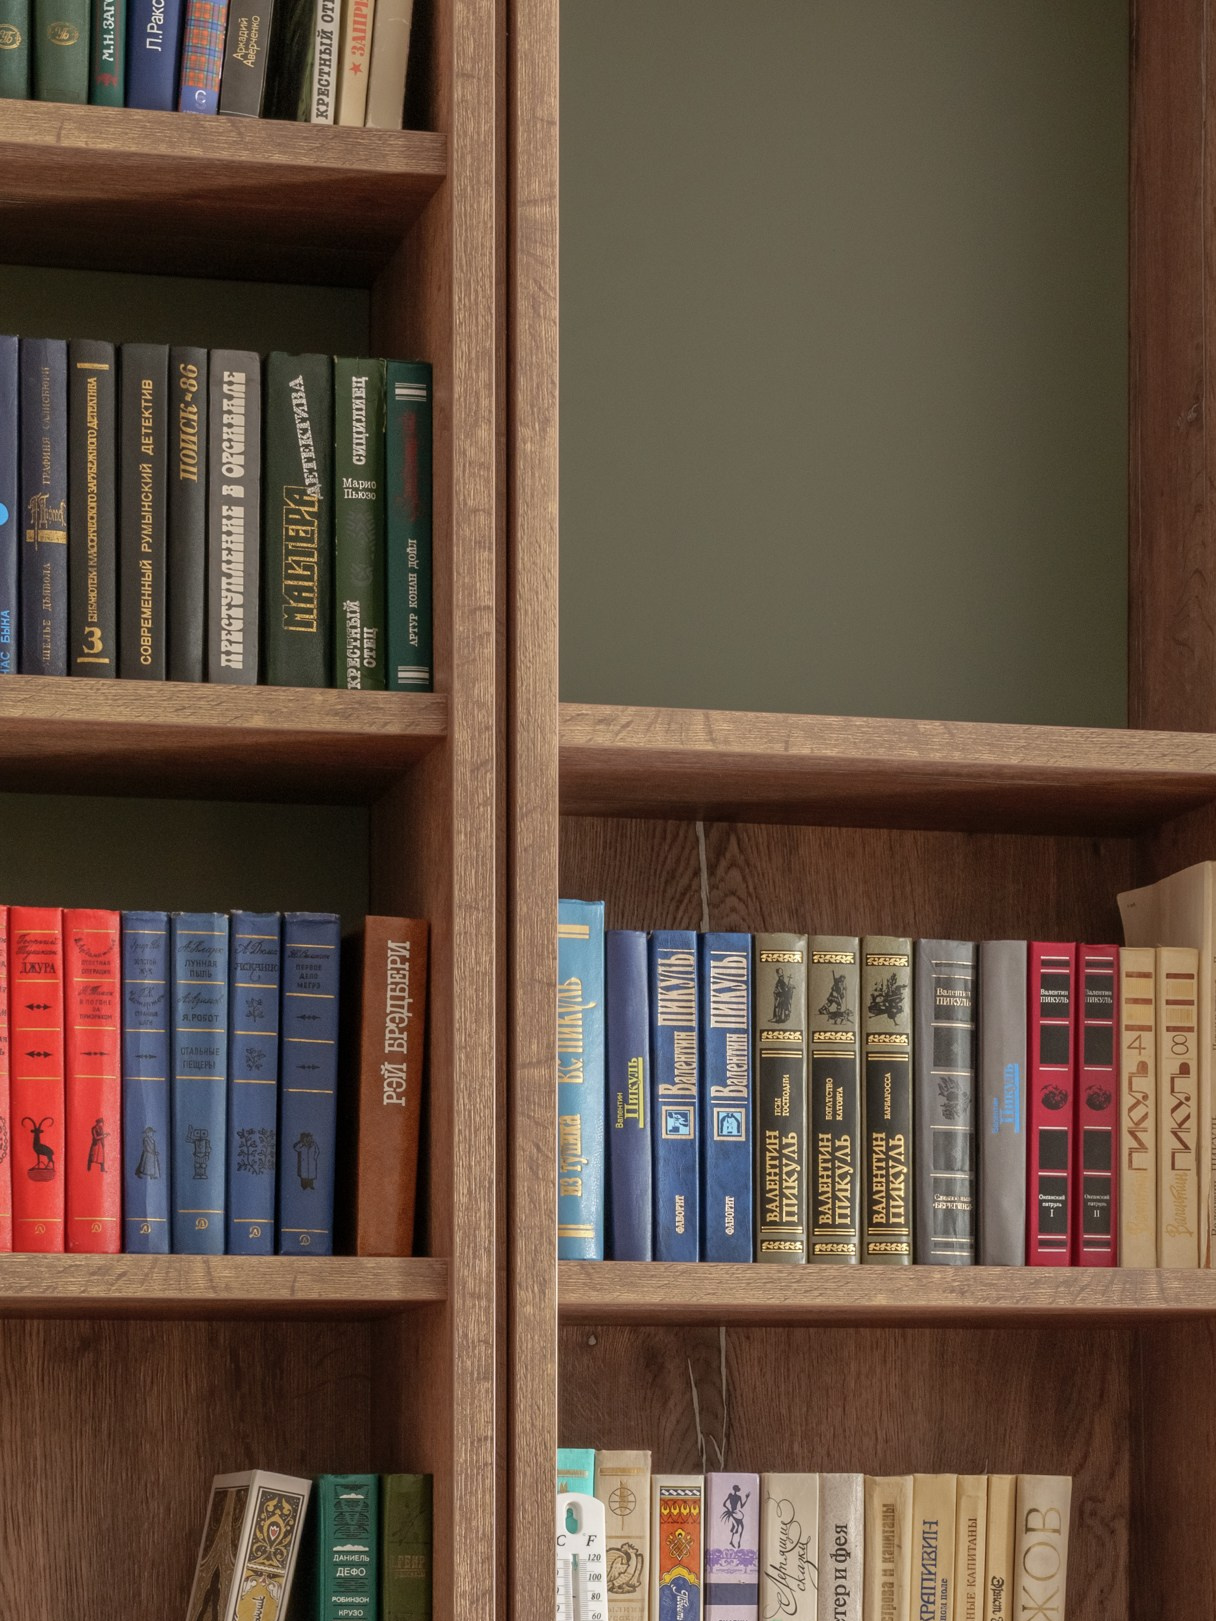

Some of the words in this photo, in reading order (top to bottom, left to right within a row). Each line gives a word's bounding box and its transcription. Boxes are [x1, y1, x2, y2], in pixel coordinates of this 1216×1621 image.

[234, 18, 248, 60] Аркадий
[245, 16, 261, 67] Аверченко
[316, 28, 333, 119] КРЕСТНЫЙ
[87, 377, 98, 429] ДЕТЕКТИВА
[141, 379, 153, 455] ДЕТЕКТИВ
[222, 371, 246, 478] ОРСИВАЛЕ
[351, 376, 368, 465] СИЦИЛИЕЦ
[87, 430, 98, 493] ЗАРУБЕЖНОГО
[289, 375, 324, 499] ДЕТЕКТИВА
[139, 464, 153, 552] РУМЫНСКИЙ
[222, 484, 245, 496] В
[343, 478, 377, 489] Марио
[344, 490, 376, 500] Пьюзо
[88, 494, 98, 566] КЛАССИЧЕСКОГО
[283, 485, 318, 632] МАСТЕРА
[406, 539, 419, 568] ДОЙЛ
[88, 567, 98, 622] БИБЛИОТЕКА
[139, 560, 153, 665] СОВРЕМЕННЫЙ
[221, 505, 244, 669] ПРЕСТУПЛЕНИЕ
[407, 573, 419, 608] КОНАН
[344, 600, 361, 689] КРЕСТНЫЙ
[364, 627, 378, 668] ОТЕЦ
[407, 612, 418, 647] АРТУР
[20, 962, 56, 974] ДЖУРА
[185, 960, 217, 968] ЛУННАЯ
[658, 953, 695, 1027] ПИКУЛЬ
[710, 956, 747, 1029] ПИКУЛЬ
[383, 940, 412, 1053] БРЭДБЕРИ
[659, 1031, 696, 1095] Валентин
[711, 1033, 748, 1098] Валентин
[1172, 1034, 1188, 1056] 8
[381, 1062, 407, 1106] РЭЙ
[616, 1092, 624, 1128] Валентин
[624, 1058, 641, 1119] Пикуль
[781, 1074, 790, 1116] ГОСПОДНИ
[825, 1078, 833, 1120] БОГАТСТВО
[766, 1130, 780, 1222] ВАЛЕНТИН
[782, 1132, 801, 1222] ПИКУЛЬ
[819, 1133, 832, 1224] ВАЛЕНТИН
[835, 1134, 853, 1225] ПИКУЛЬ
[873, 1132, 887, 1224] ВАЛЕНТИН
[889, 1134, 906, 1225] ПИКУЛЬ
[588, 1553, 602, 1562] 120
[829, 1524, 852, 1563] фея
[882, 1503, 895, 1563] капитаны
[966, 1517, 978, 1587] КАПИТАНЫ
[336, 1568, 366, 1576] ДЕФО
[588, 1573, 602, 1581] 100
[591, 1593, 600, 1601] 80
[835, 1568, 846, 1580] и
[592, 1612, 602, 1620] 60
